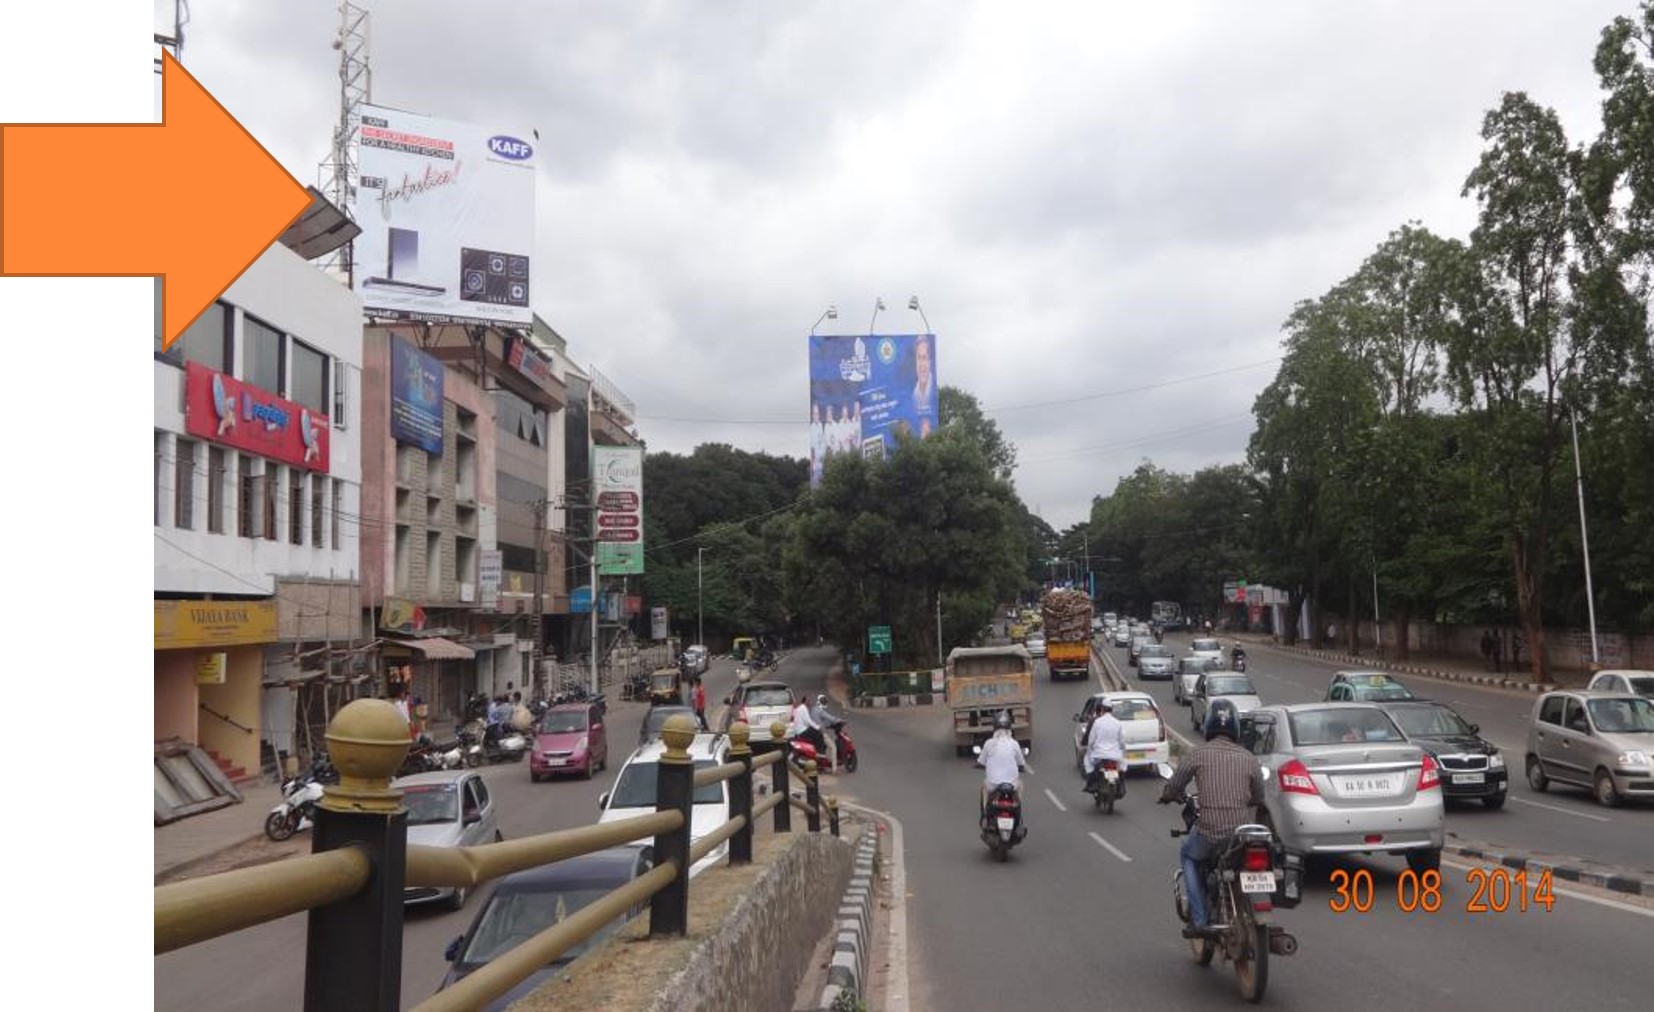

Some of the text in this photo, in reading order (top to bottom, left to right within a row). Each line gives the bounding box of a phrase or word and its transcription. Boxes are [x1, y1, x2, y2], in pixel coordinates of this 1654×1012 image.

[492, 139, 530, 157] KAFF
[190, 608, 249, 624] VIJAYA BANK
